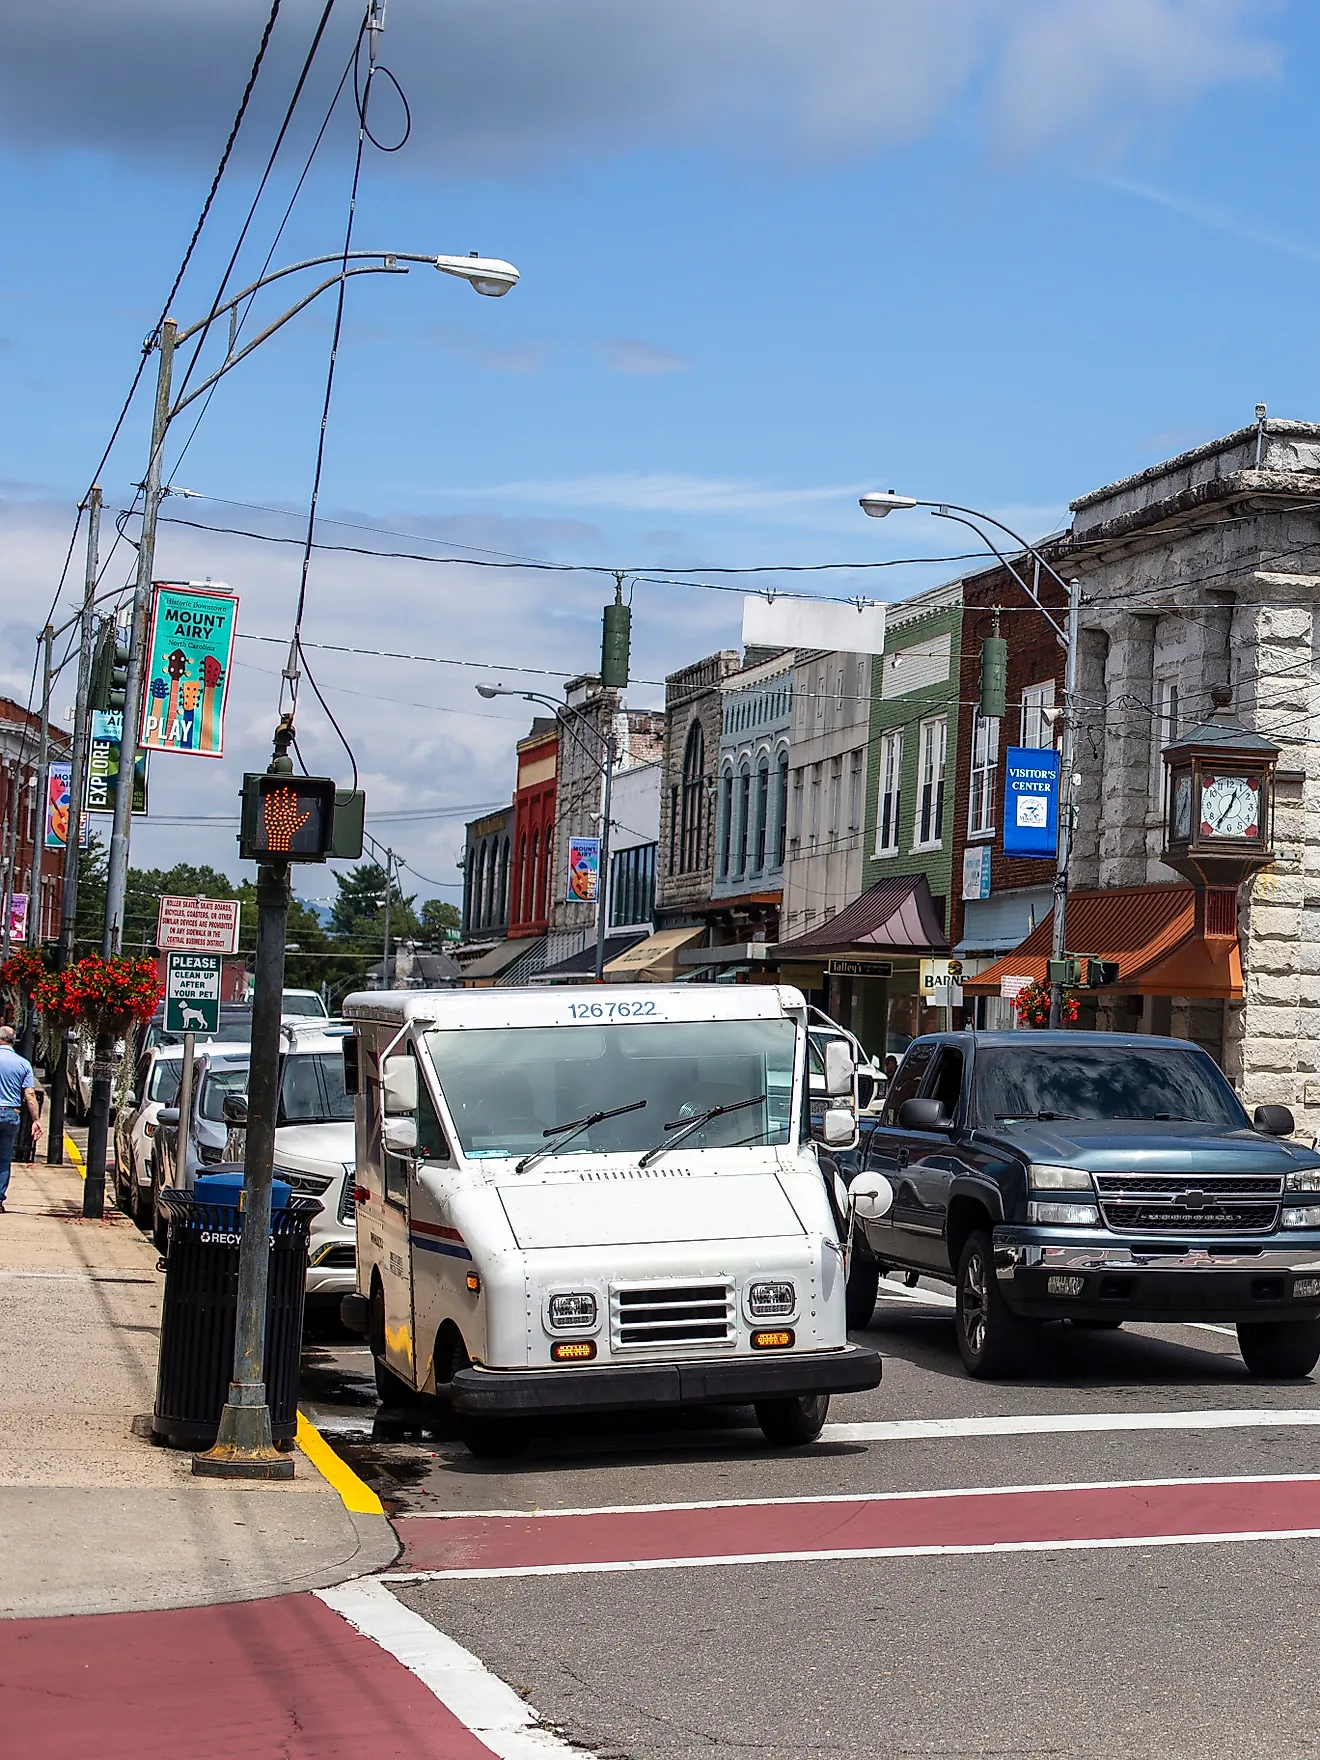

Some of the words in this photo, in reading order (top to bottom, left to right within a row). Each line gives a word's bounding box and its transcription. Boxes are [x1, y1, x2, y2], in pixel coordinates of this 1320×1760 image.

[166, 598, 191, 608] Historic
[193, 602, 227, 612] Downtown
[165, 609, 226, 629] MOUNT
[174, 624, 214, 640] AIRY
[168, 640, 187, 648] North
[188, 642, 215, 652] Carolina
[146, 716, 193, 742] PLAY
[89, 741, 110, 805] EXPLORE
[1009, 768, 1056, 780] VISITOR'S
[1012, 781, 1051, 792] CENTER
[1226, 780, 1235, 789] 12
[1209, 789, 1218, 798] 10
[1245, 792, 1251, 800] 2
[1206, 801, 1212, 810] 9
[1248, 804, 1254, 812] 3
[1208, 812, 1215, 820] 8
[1244, 814, 1251, 822] 4
[1226, 824, 1232, 832] 6
[1236, 822, 1243, 830] 5
[586, 869, 598, 899] CREATE
[200, 902, 213, 910] SKATE
[180, 919, 197, 927] DEVICES
[208, 922, 233, 930] PROHIBITED
[186, 928, 206, 936] SIDEWALK
[166, 936, 185, 944] CENTRAL
[186, 938, 206, 946] BUSINESS
[206, 939, 225, 947] DISTRICT
[172, 956, 217, 969] PLEASE
[833, 961, 862, 974] Talley's
[204, 972, 214, 980] UP
[180, 981, 206, 989] AFTER
[174, 990, 196, 998] YOUR
[568, 1001, 657, 1019] 1267622
